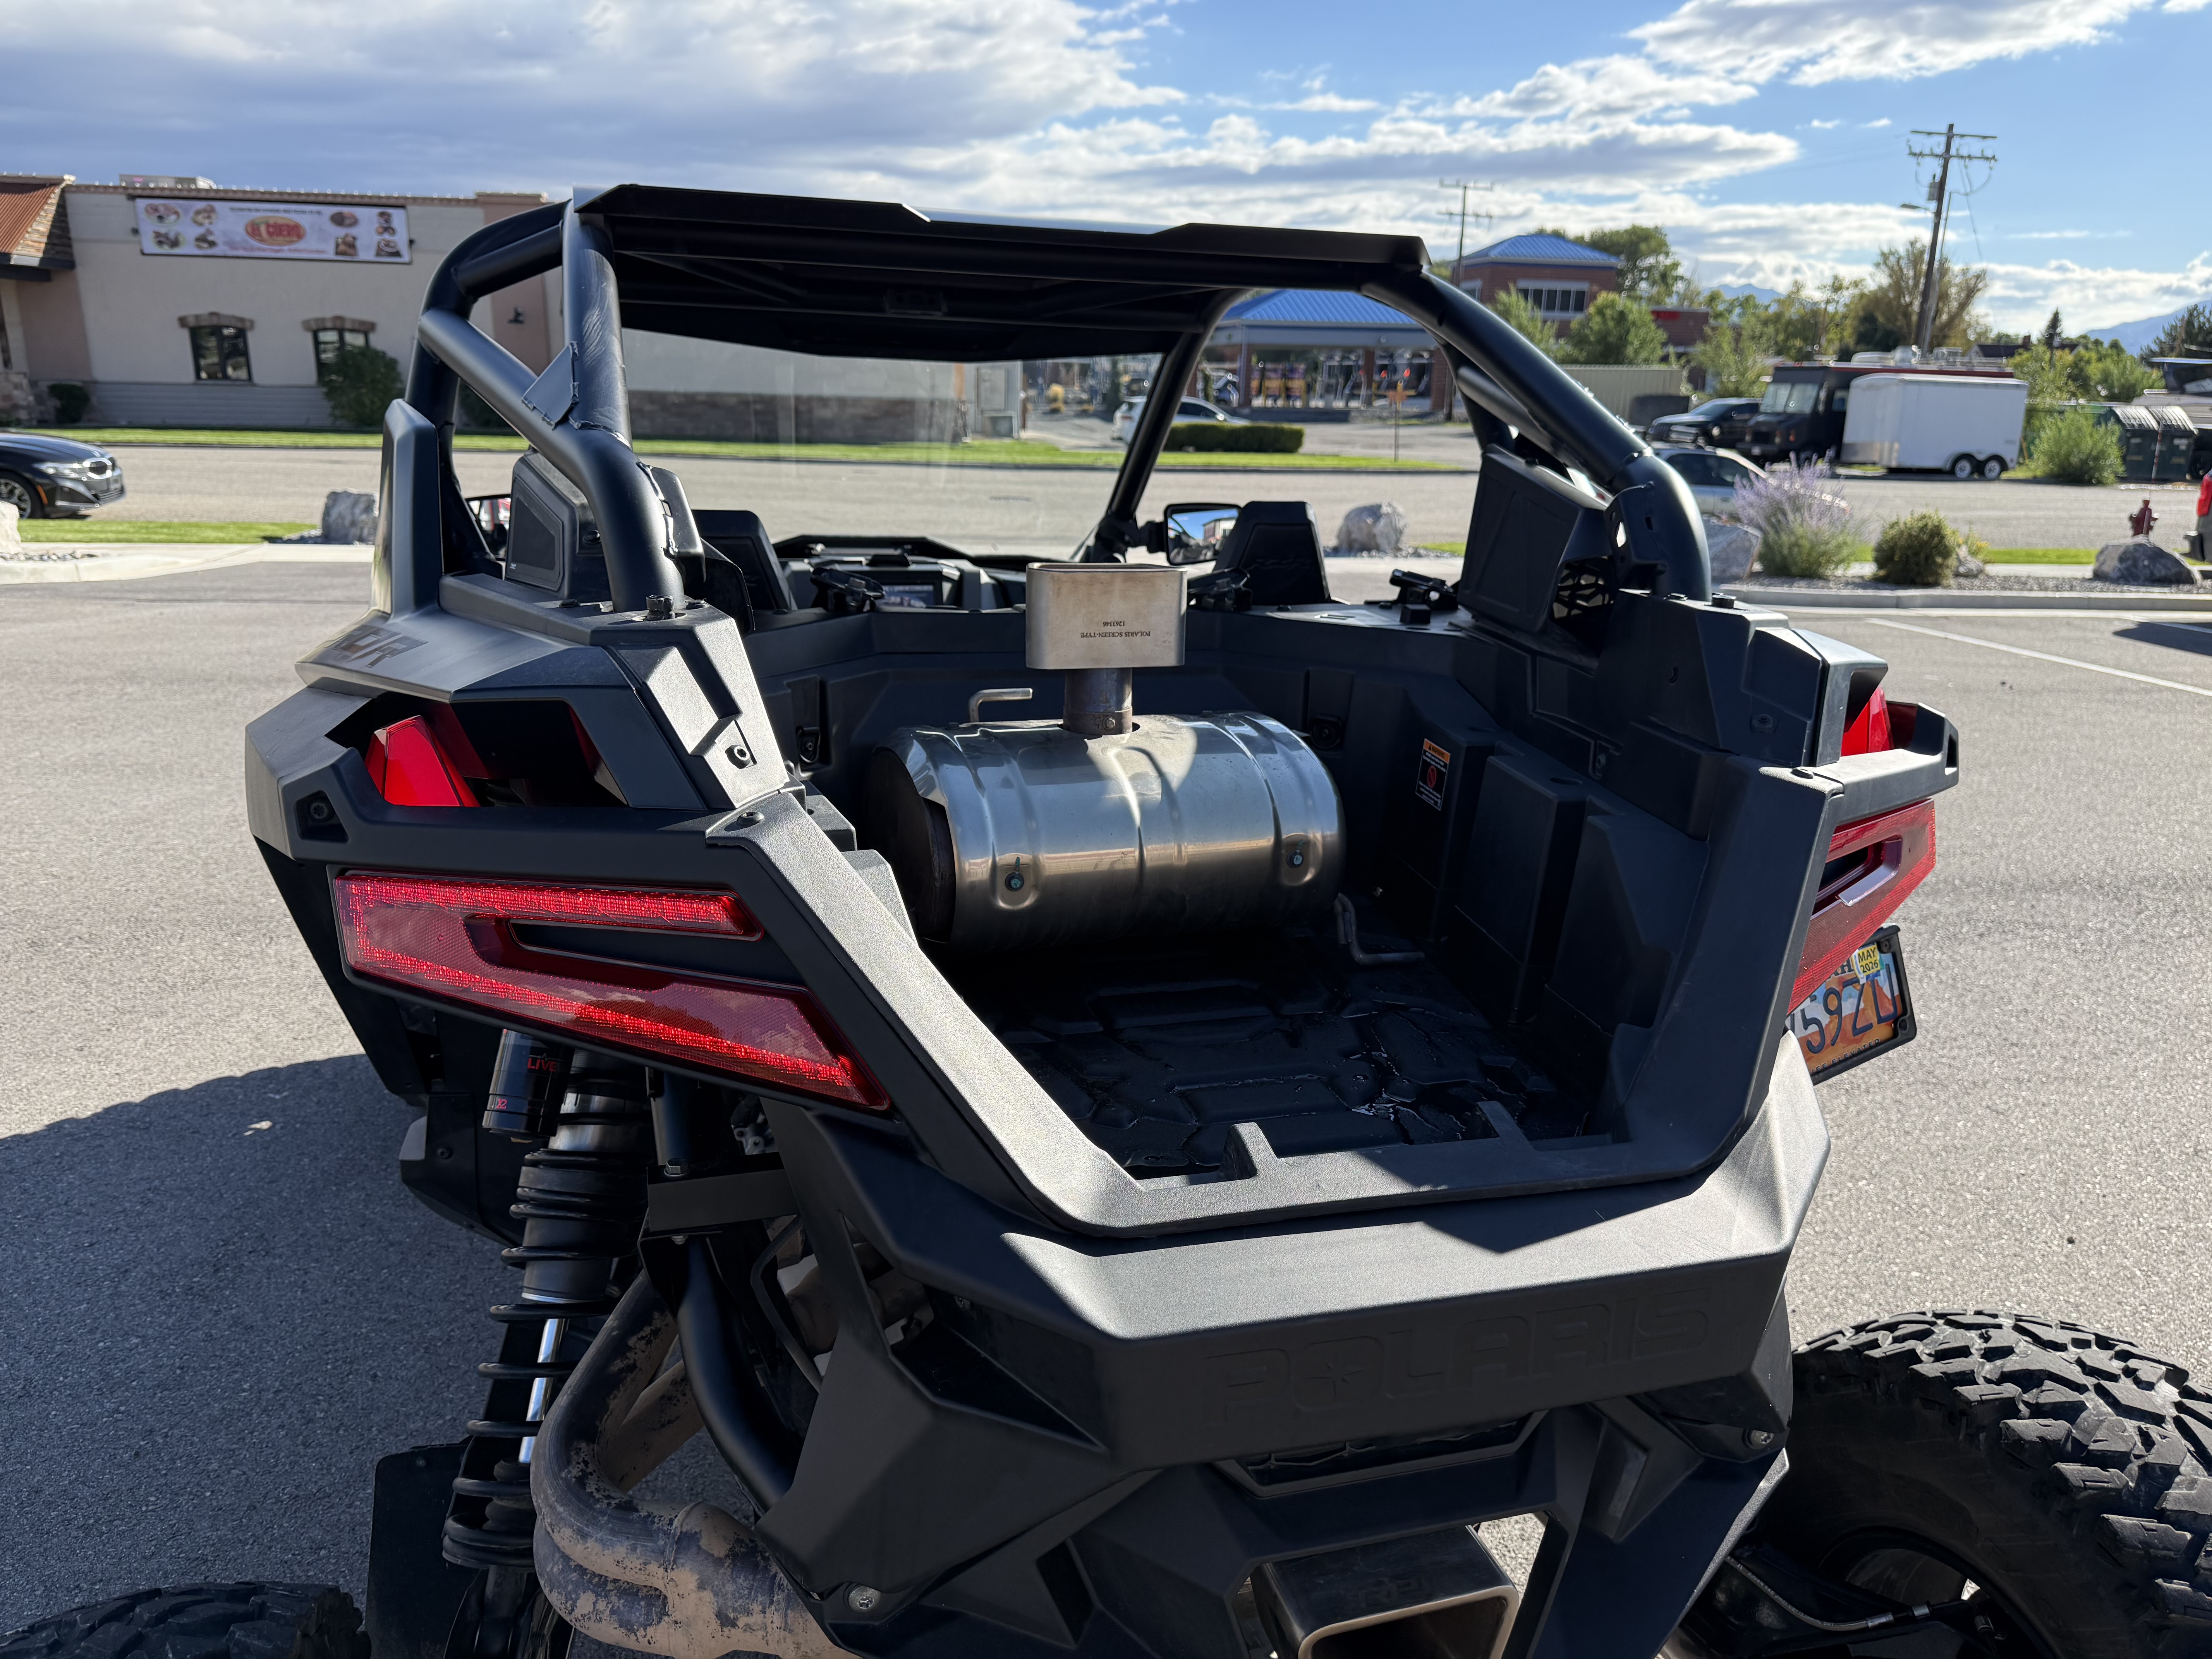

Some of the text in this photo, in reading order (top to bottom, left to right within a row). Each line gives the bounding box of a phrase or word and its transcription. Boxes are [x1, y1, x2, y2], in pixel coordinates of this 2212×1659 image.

[1858, 947, 1877, 963] MAY
[1860, 960, 1879, 974] 2026
[1789, 963, 1898, 1054] 59ZU
[527, 1058, 558, 1072] LIVE
[496, 1098, 507, 1109] X2
[1201, 1287, 1711, 1430] POLARIS
